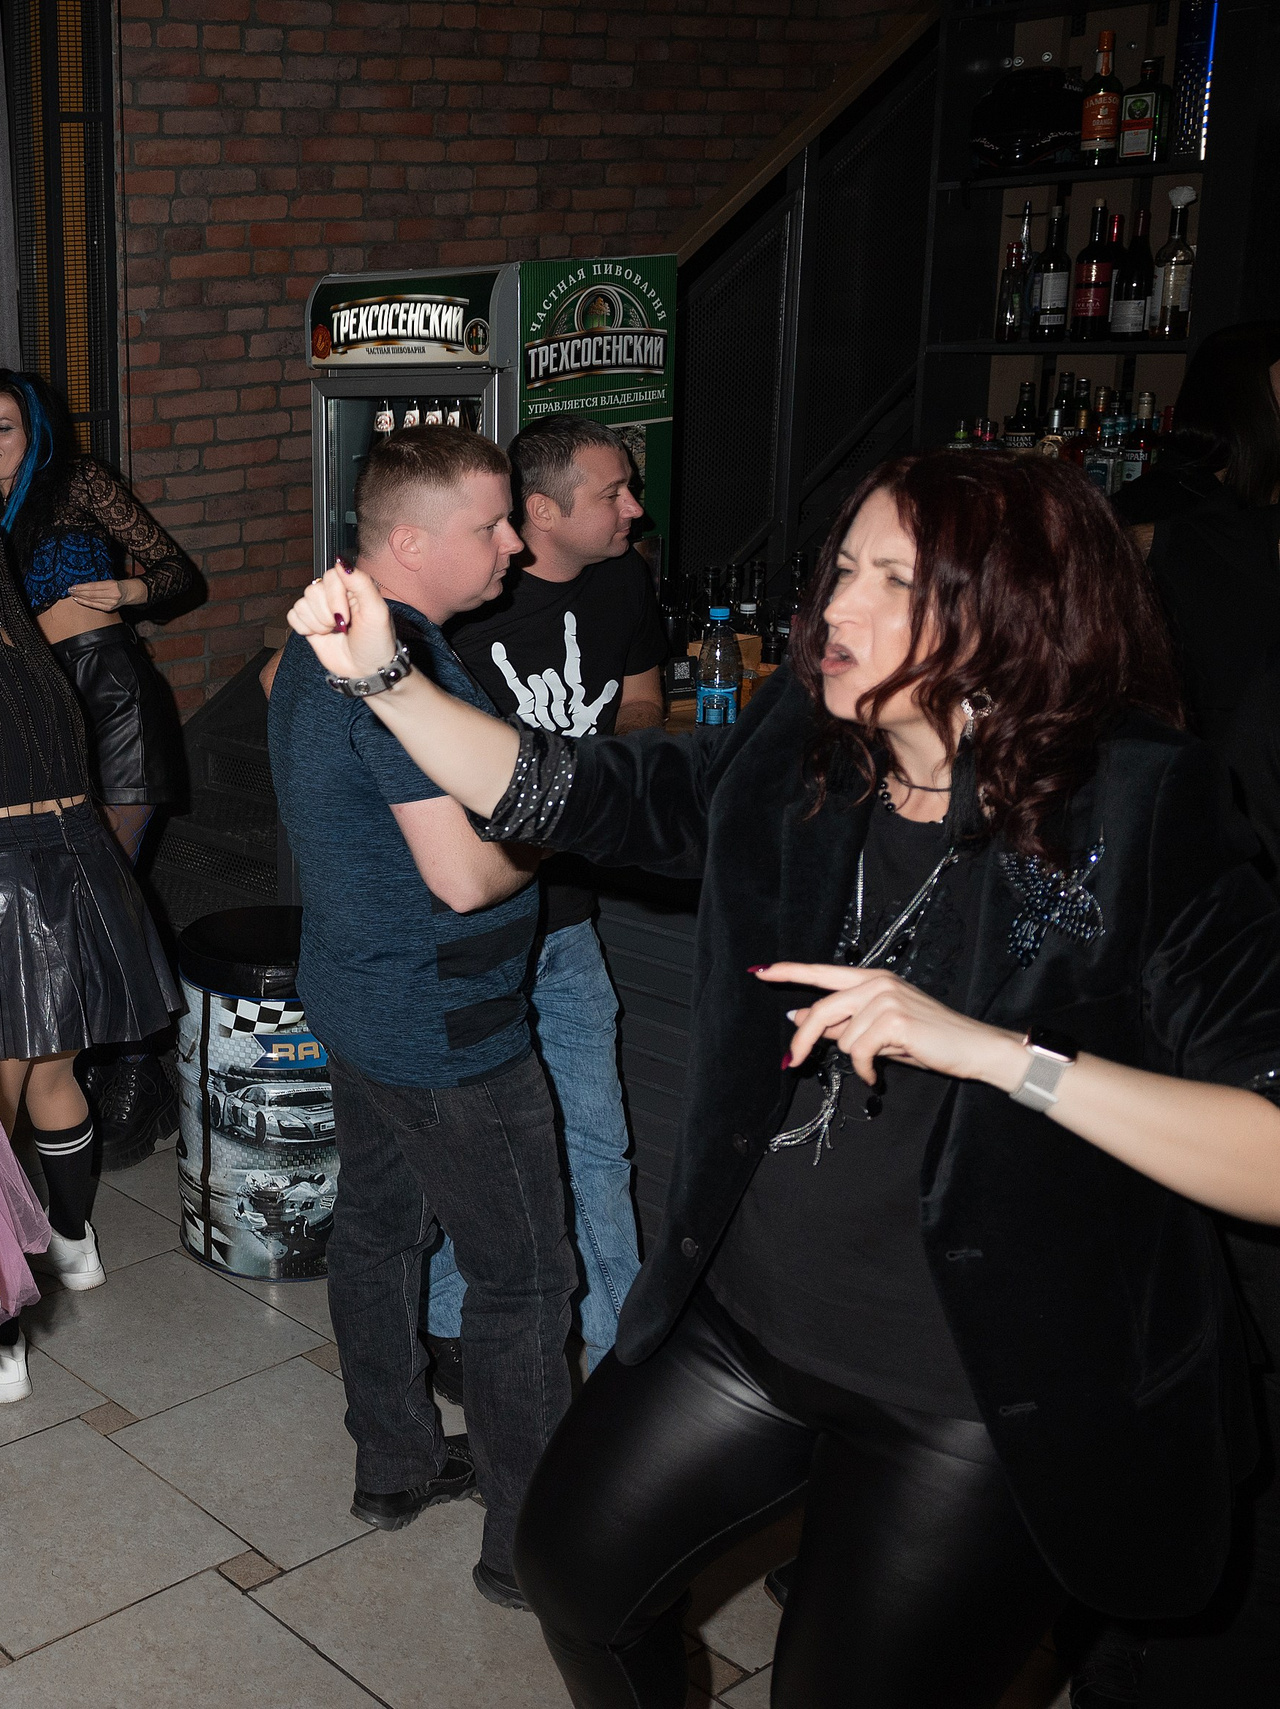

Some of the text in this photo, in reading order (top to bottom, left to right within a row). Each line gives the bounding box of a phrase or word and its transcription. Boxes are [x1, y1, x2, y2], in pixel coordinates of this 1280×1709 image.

[529, 263, 667, 333] ЧАСТНАЯ ПИВОВАРНЯ
[331, 302, 465, 345] ТРЕХСОСЕНСКИЙ
[365, 346, 391, 355] ЧАСТНАЯ
[527, 334, 664, 380] ТРЕХСОСЕНСКИЙ
[527, 389, 666, 415] УПРАВЛЯЕТСЯ ВЛАДЕЛЬЦЕМ
